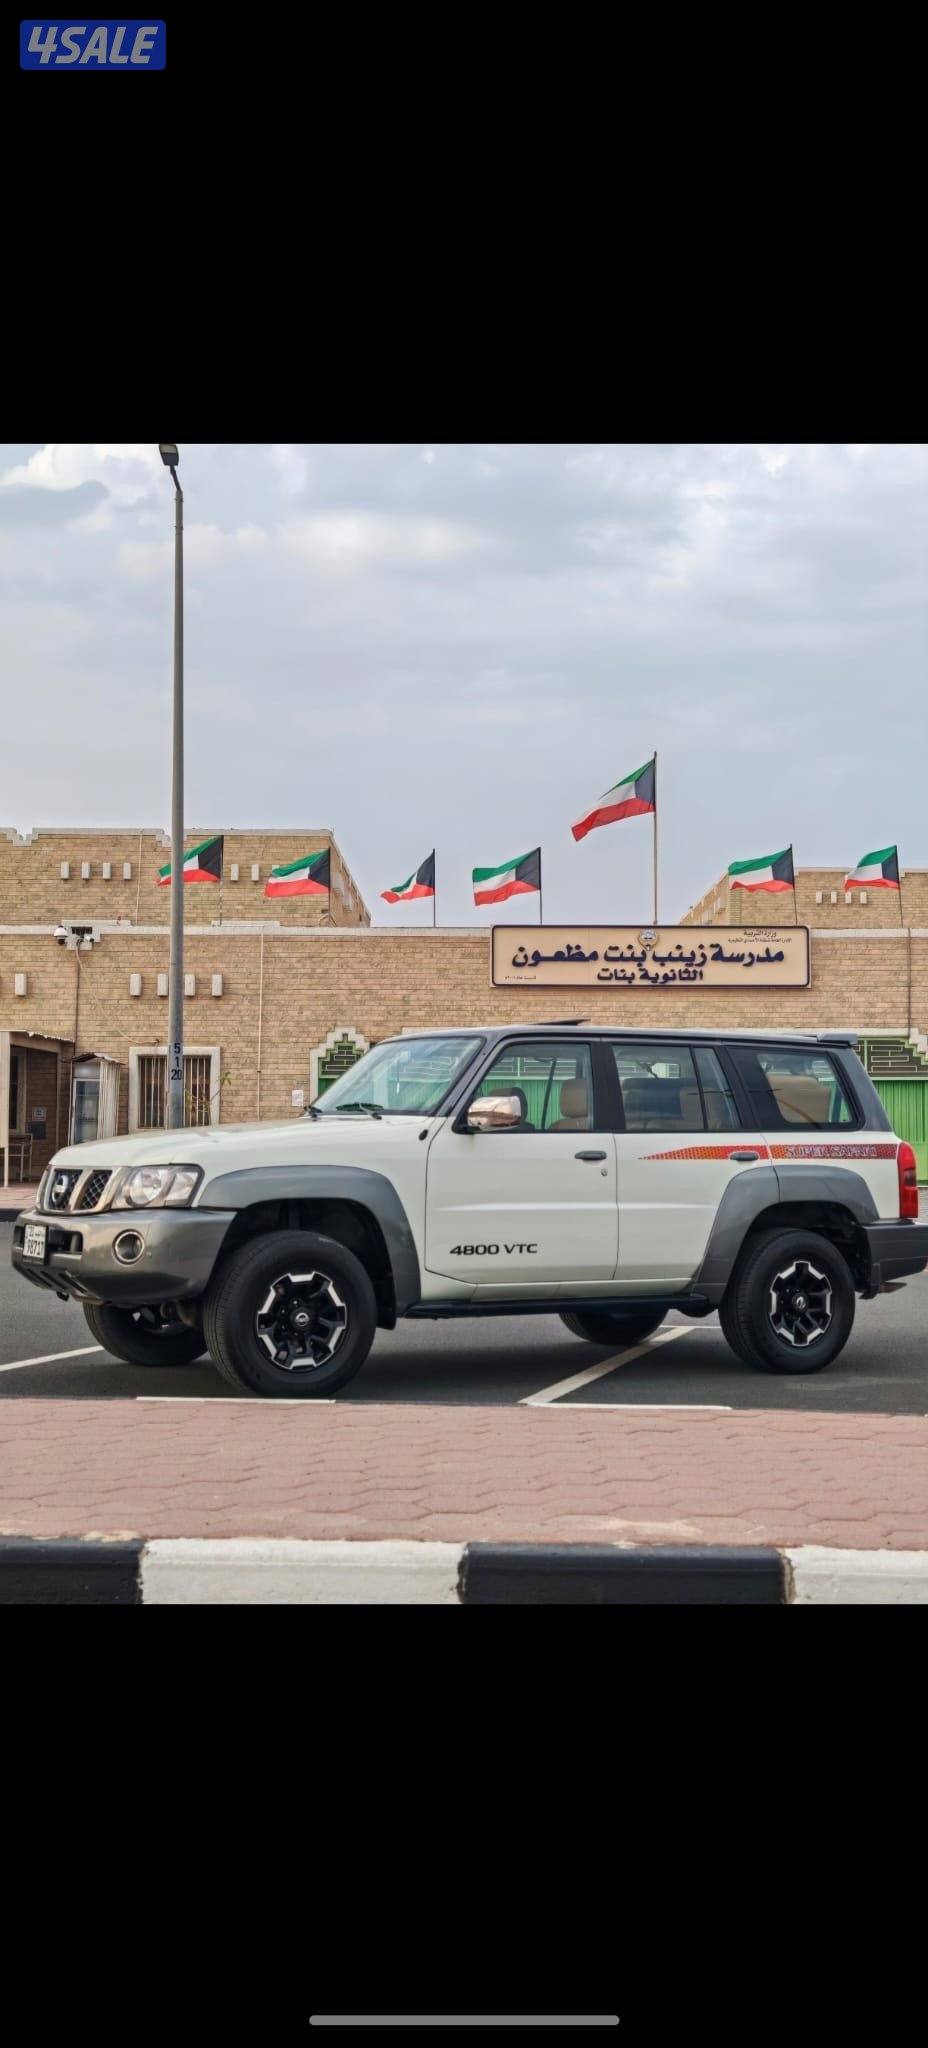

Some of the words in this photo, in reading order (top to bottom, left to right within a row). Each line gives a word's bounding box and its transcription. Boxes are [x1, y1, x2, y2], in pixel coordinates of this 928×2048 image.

[511, 943, 599, 968] مظعون
[603, 944, 647, 967] بنت
[652, 943, 708, 967] زينب
[709, 943, 785, 967] مدرسة
[597, 967, 636, 984] بنات
[639, 967, 704, 984] الثانوية
[174, 1042, 181, 1054] 5
[175, 1056, 180, 1068] 1
[170, 1068, 183, 1081] 20
[449, 1244, 500, 1256] 4800
[503, 1243, 538, 1254] VTC
